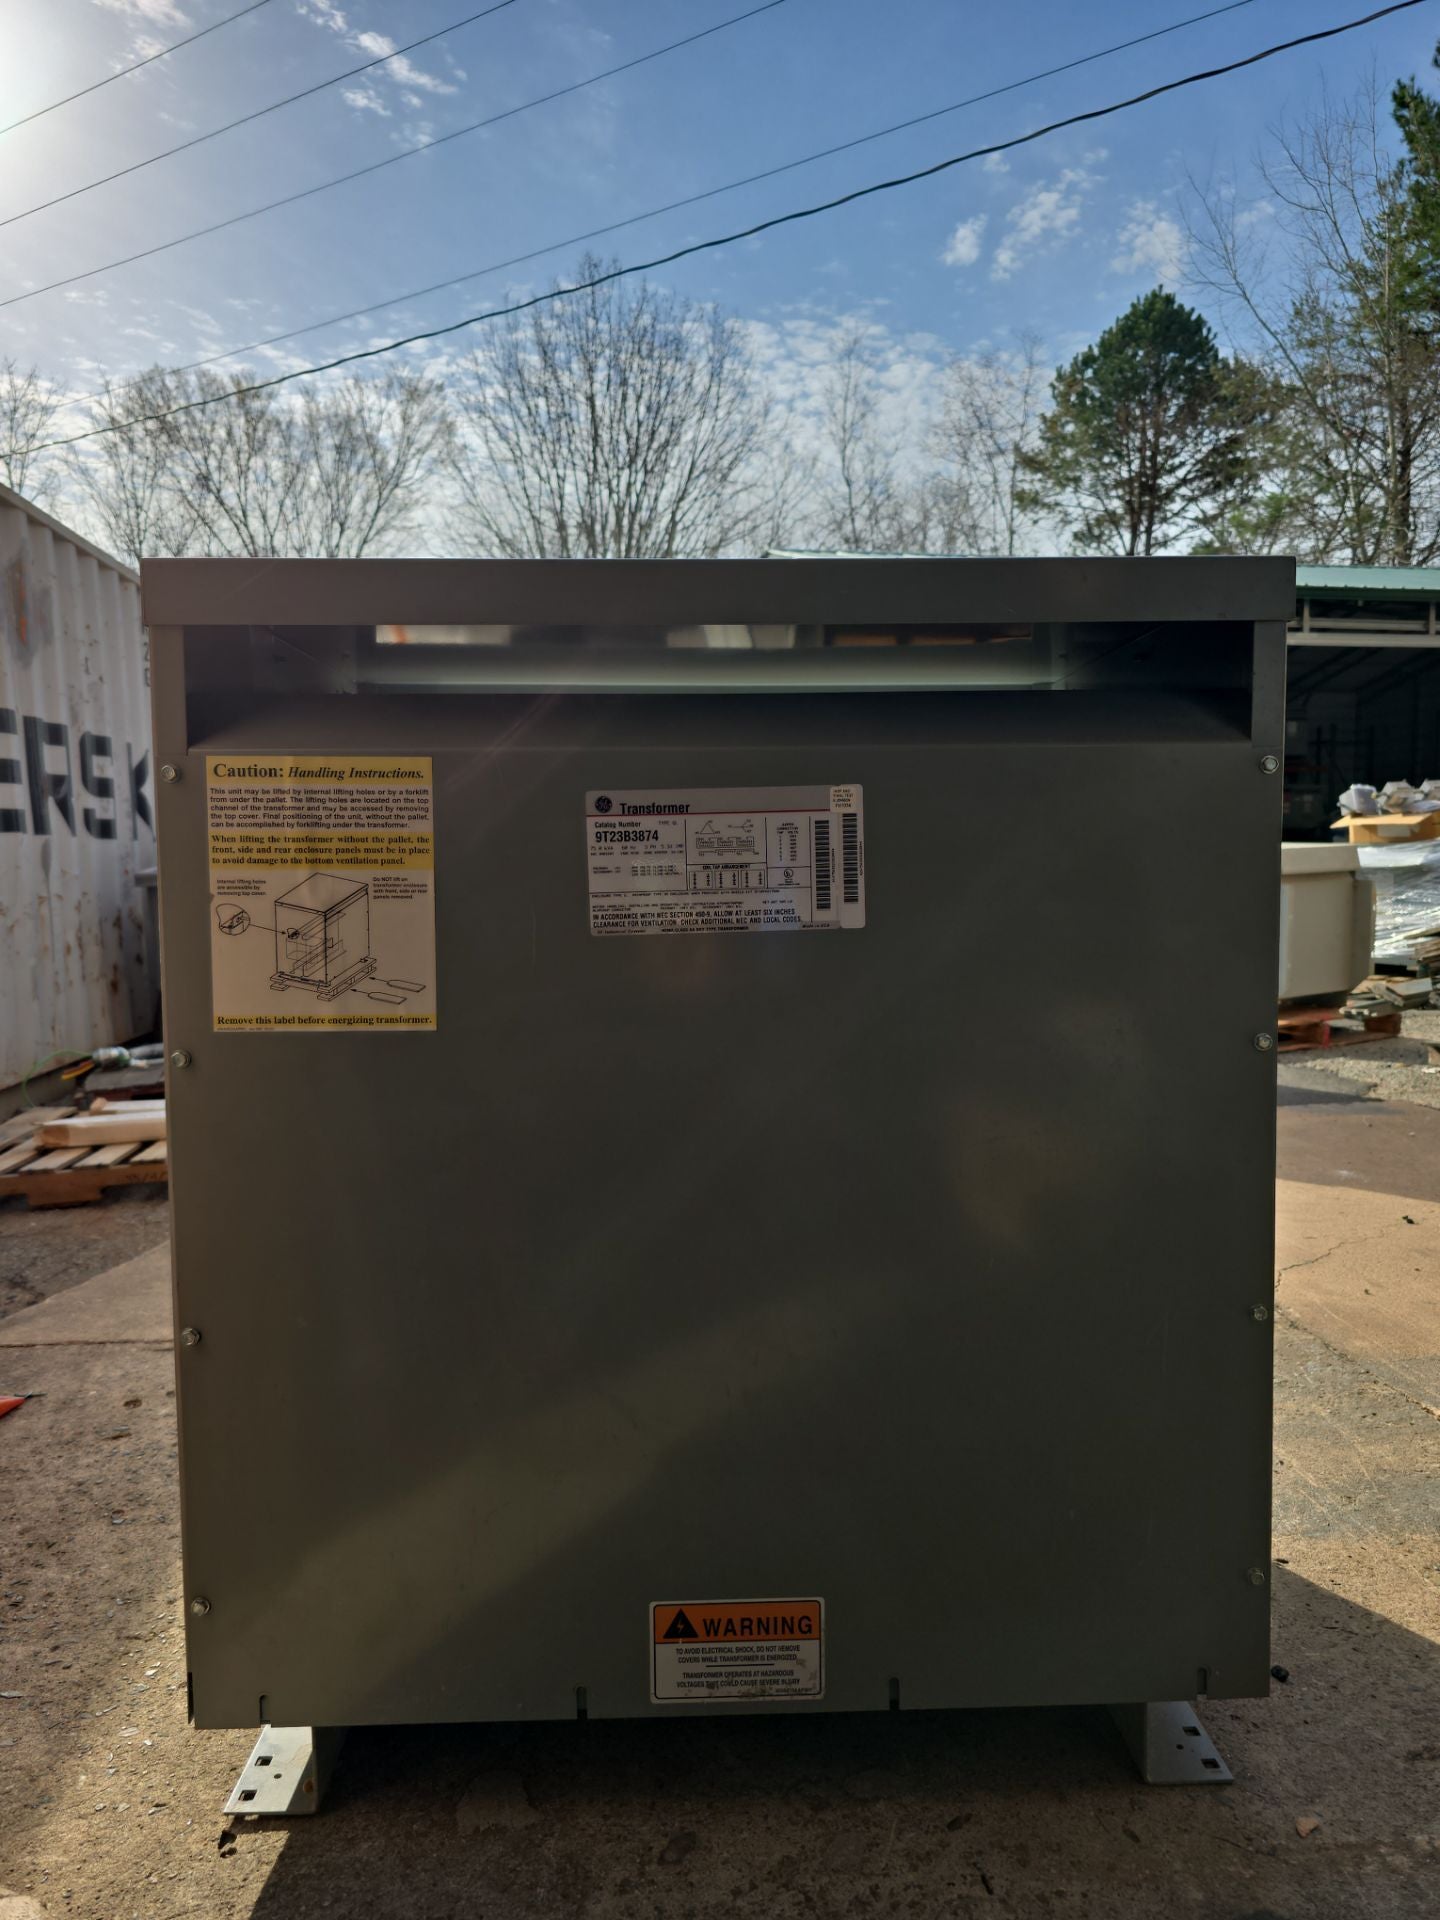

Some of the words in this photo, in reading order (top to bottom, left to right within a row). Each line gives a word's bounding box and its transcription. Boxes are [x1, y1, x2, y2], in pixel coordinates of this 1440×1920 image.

[213, 763, 284, 778] Caution:
[287, 766, 346, 780] Handling
[349, 767, 424, 780] Instructions.
[245, 788, 259, 796] may
[293, 788, 301, 796] by
[334, 788, 354, 796] lifting
[388, 788, 396, 796] by
[386, 805, 394, 813] by
[397, 805, 429, 813] removing
[619, 802, 690, 815] Transformer
[225, 813, 236, 821] top
[283, 813, 322, 821] positioning
[595, 822, 616, 830] Catalog
[212, 835, 236, 843] When
[240, 835, 265, 845] lifting
[268, 835, 281, 843] the
[284, 835, 333, 843] transformer
[338, 835, 368, 843] without
[372, 835, 385, 843] the
[417, 835, 430, 843] the
[595, 830, 659, 844] 9T23B3874
[238, 846, 253, 854] side
[257, 846, 272, 854] and
[274, 846, 291, 854] rear
[294, 846, 332, 854] enclosure
[336, 846, 361, 855] panels
[364, 846, 384, 854] must
[387, 846, 396, 854] be
[399, 846, 406, 854] in
[409, 846, 430, 855] place
[247, 857, 278, 866] damage
[381, 857, 406, 866] panel.
[218, 1016, 253, 1024] Remove
[256, 1016, 271, 1024] this
[274, 1016, 295, 1024] label
[298, 1016, 326, 1024] before
[328, 1016, 374, 1026] energizing
[376, 1016, 432, 1024] transformer.
[703, 1616, 813, 1637] WARNING
